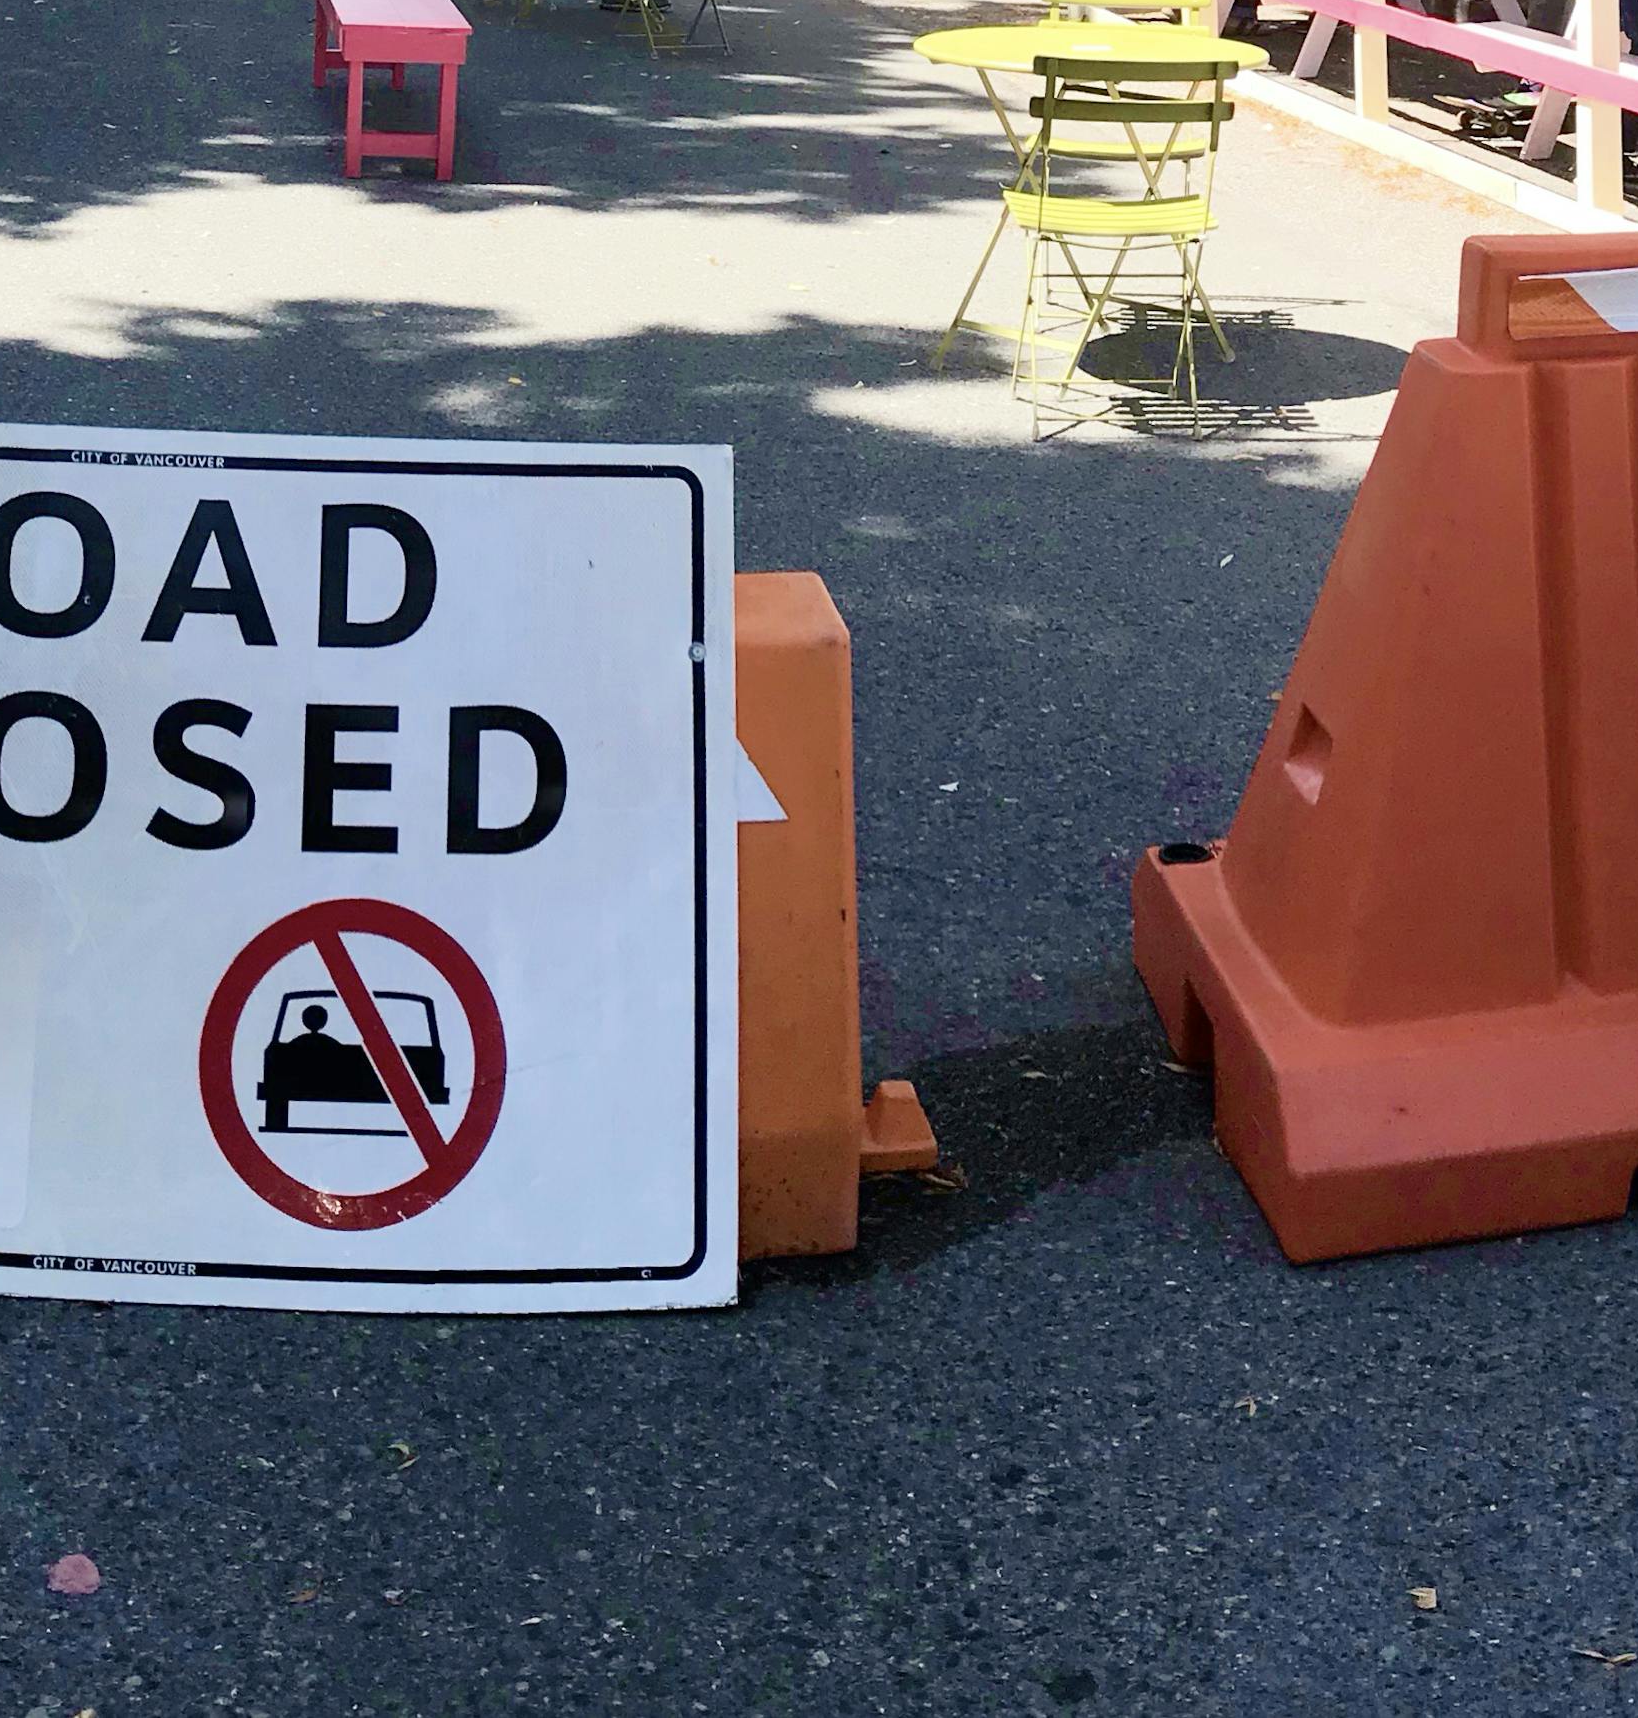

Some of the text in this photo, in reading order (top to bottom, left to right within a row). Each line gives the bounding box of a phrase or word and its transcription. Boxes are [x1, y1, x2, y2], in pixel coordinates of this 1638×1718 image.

[71, 451, 225, 468] CITY OF VANCOUVER
[33, 1257, 197, 1275] CITY OF VANCOUVER
